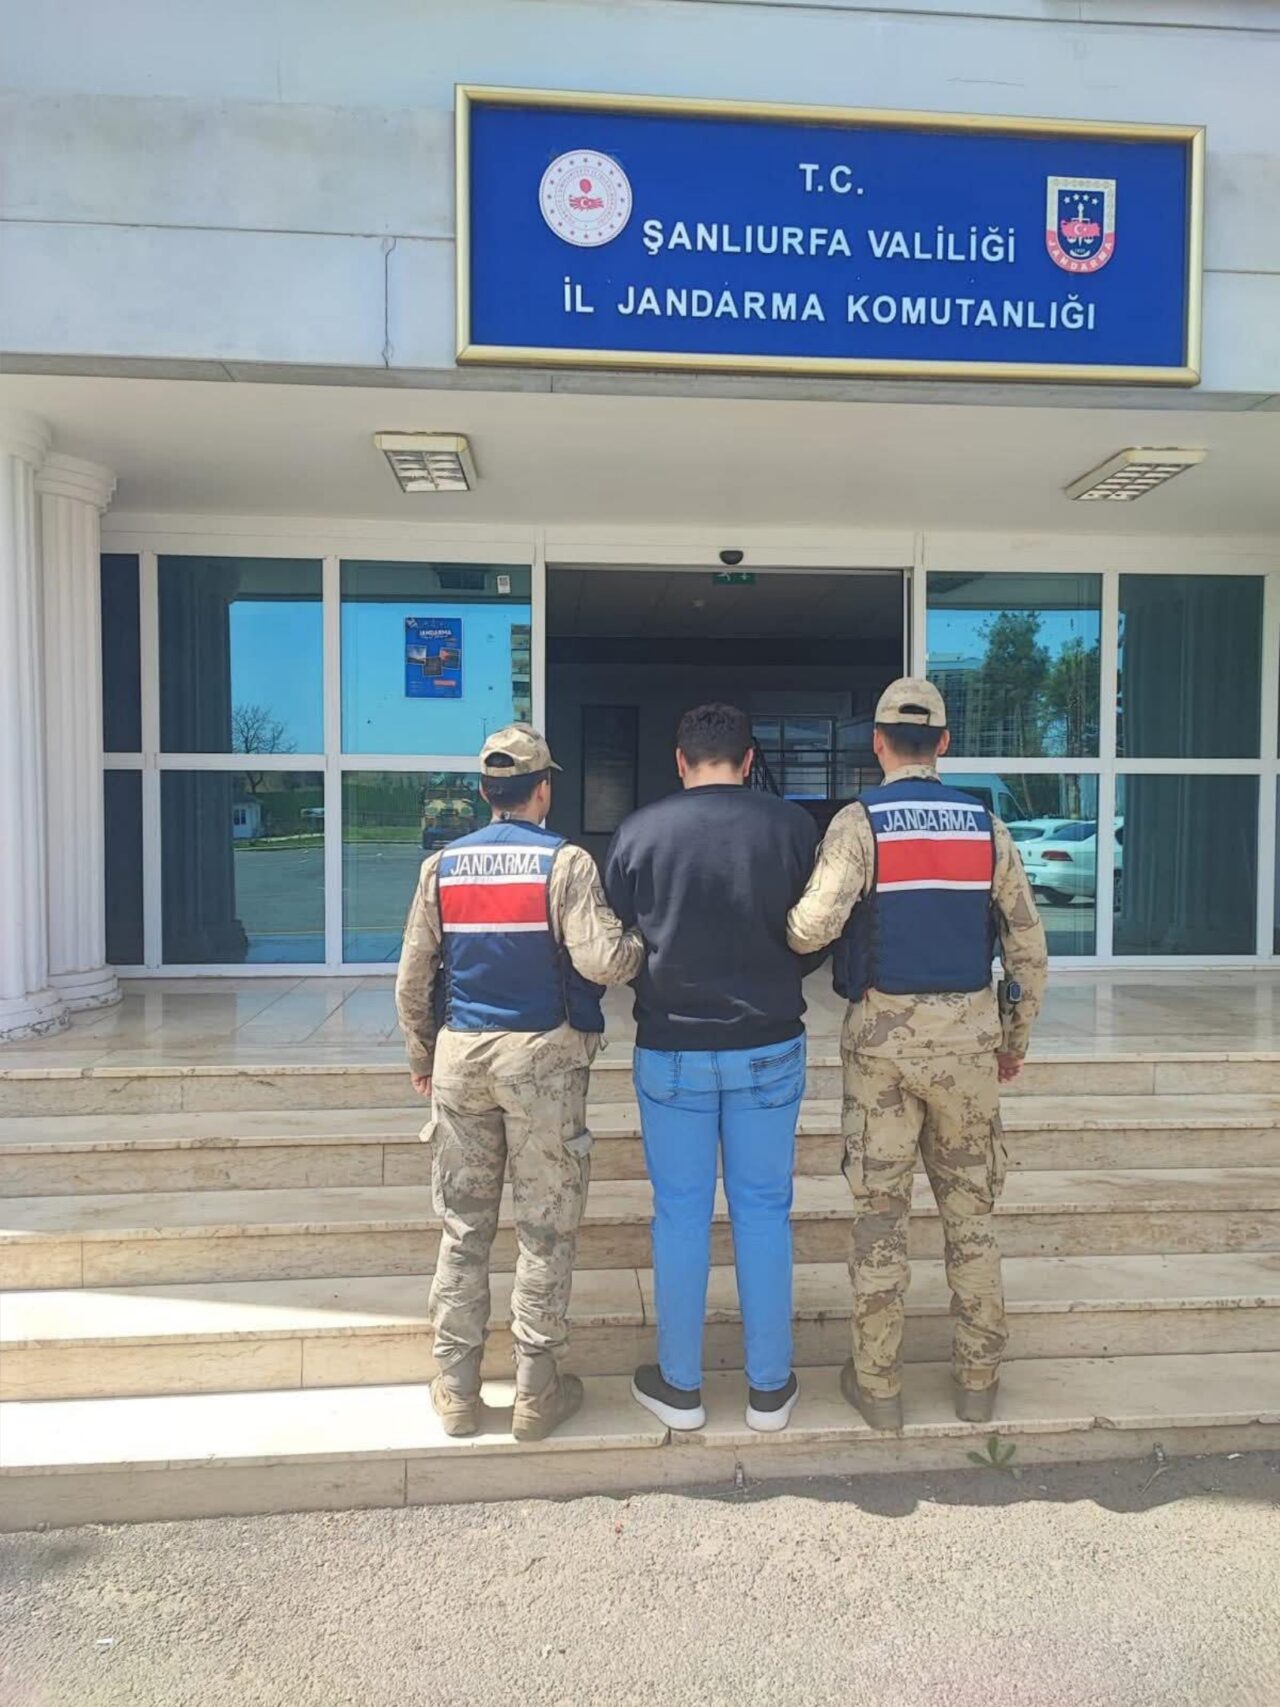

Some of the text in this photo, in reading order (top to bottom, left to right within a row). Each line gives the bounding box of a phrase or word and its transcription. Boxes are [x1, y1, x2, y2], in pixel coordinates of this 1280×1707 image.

[798, 163, 864, 195] T.C.
[642, 219, 1016, 263] ŞANLIURFA VALİLİĞİ
[563, 276, 1096, 330] İL JANDARMA KOMUTANLIĞI
[883, 808, 978, 831] JANDARMA
[450, 853, 540, 876] JANDARMA
